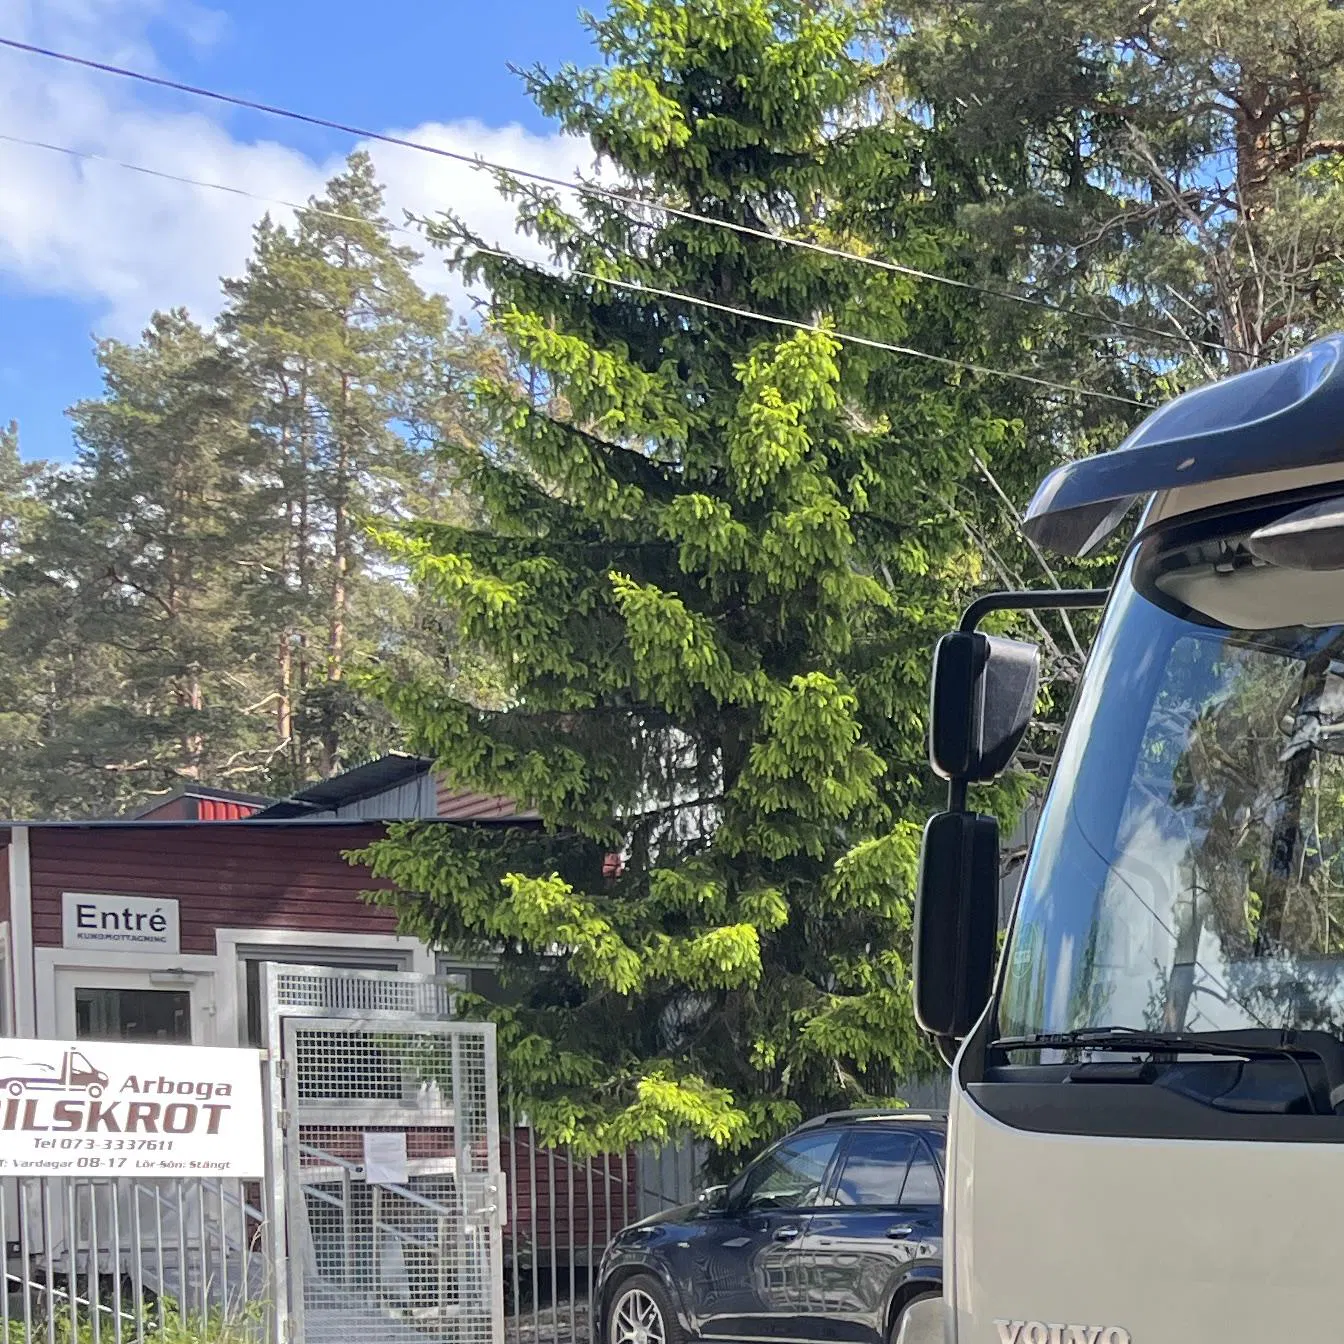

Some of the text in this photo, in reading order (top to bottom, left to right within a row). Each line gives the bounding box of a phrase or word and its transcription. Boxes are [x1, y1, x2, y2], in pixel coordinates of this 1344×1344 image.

[76, 904, 167, 932] Entré
[119, 1075, 233, 1100] Arboga
[0, 1098, 232, 1135] ILSKROT
[34, 1138, 174, 1151] Tel 073-3337611
[13, 1159, 74, 1170] Vardagar
[77, 1157, 128, 1168] 08-17
[189, 1160, 231, 1170] Stängt
